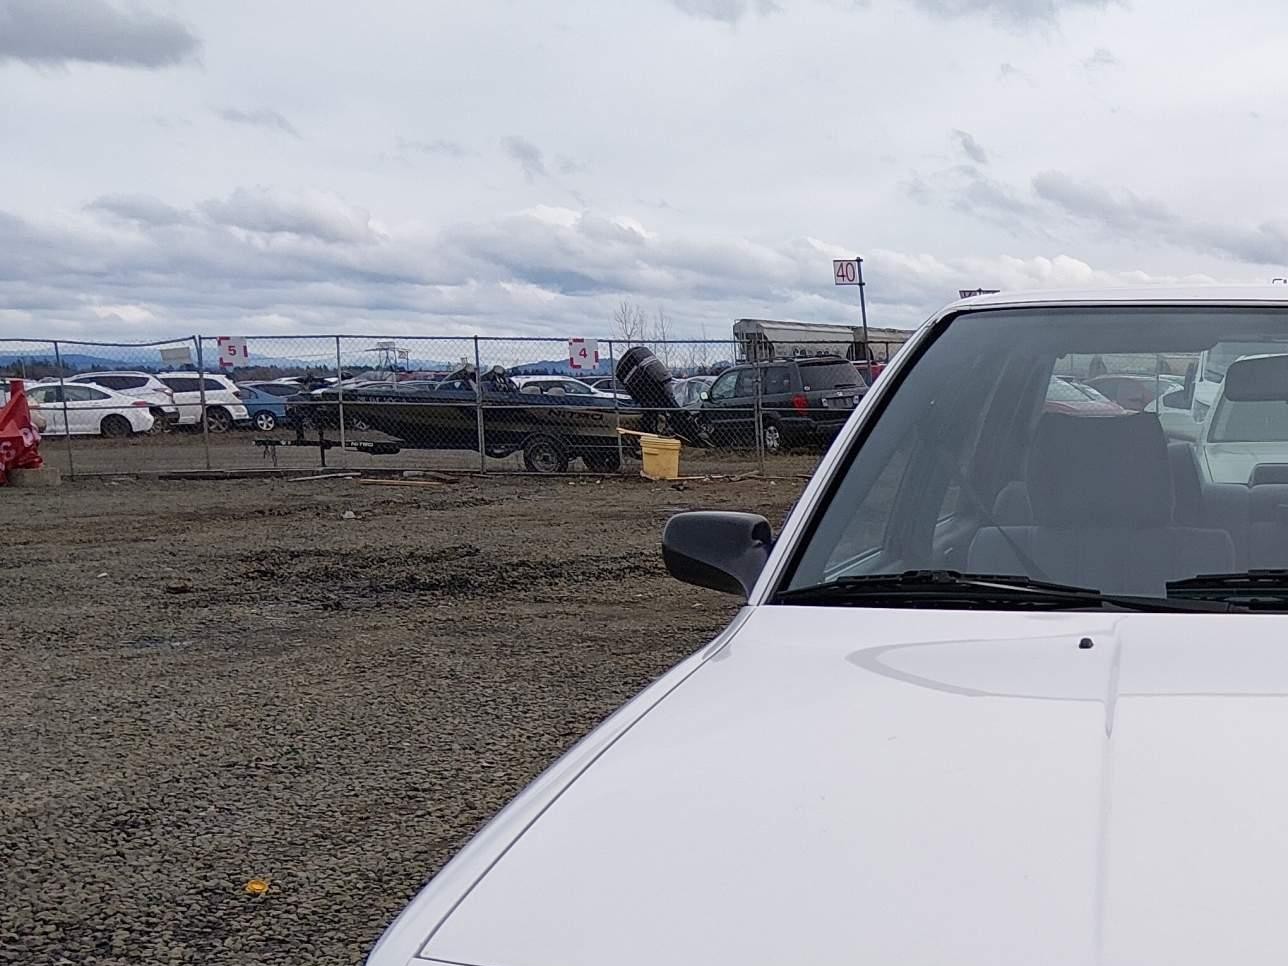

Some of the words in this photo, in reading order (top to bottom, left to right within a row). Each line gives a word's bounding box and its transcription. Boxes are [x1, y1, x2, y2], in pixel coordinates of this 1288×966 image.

[836, 262, 856, 282] 40
[228, 345, 237, 356] 5
[579, 347, 588, 359] 4
